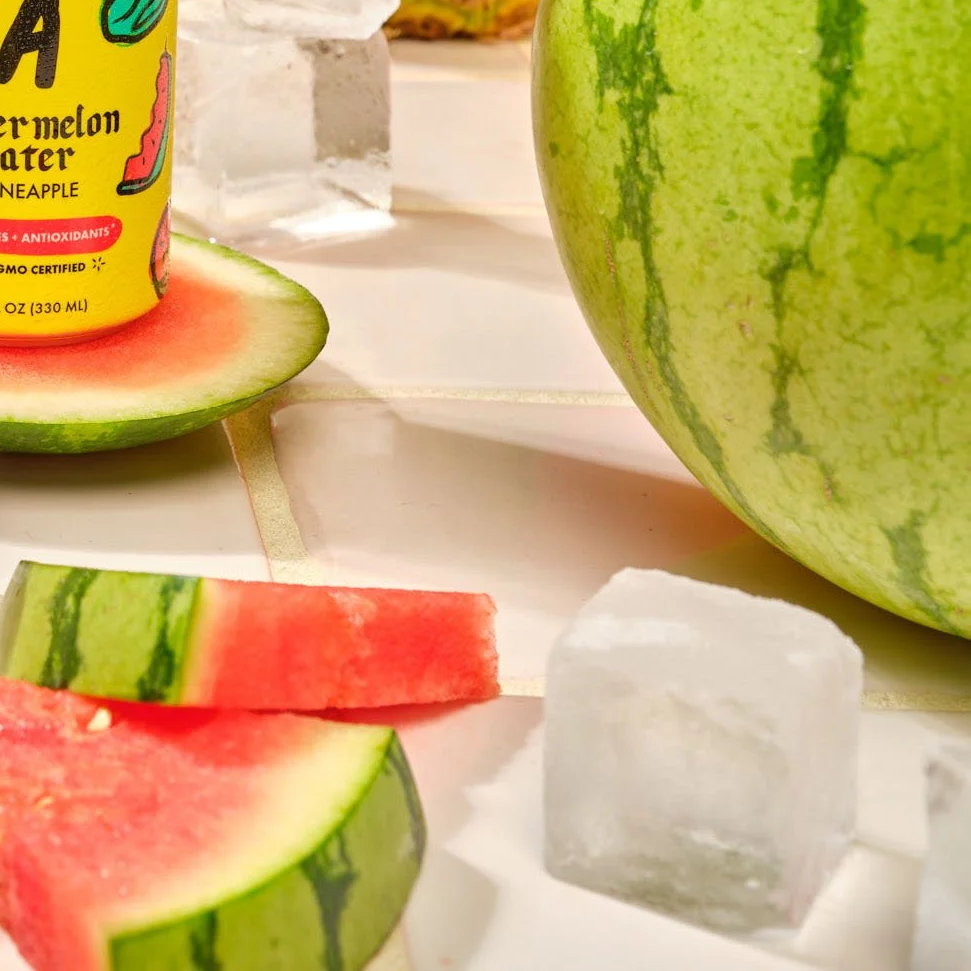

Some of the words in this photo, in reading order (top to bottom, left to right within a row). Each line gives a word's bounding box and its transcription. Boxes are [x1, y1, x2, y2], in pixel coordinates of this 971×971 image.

[31, 262, 86, 275] CERTIFIED
[5, 302, 26, 315] OZ
[30, 302, 61, 316] (330
[65, 299, 88, 313] ML)
